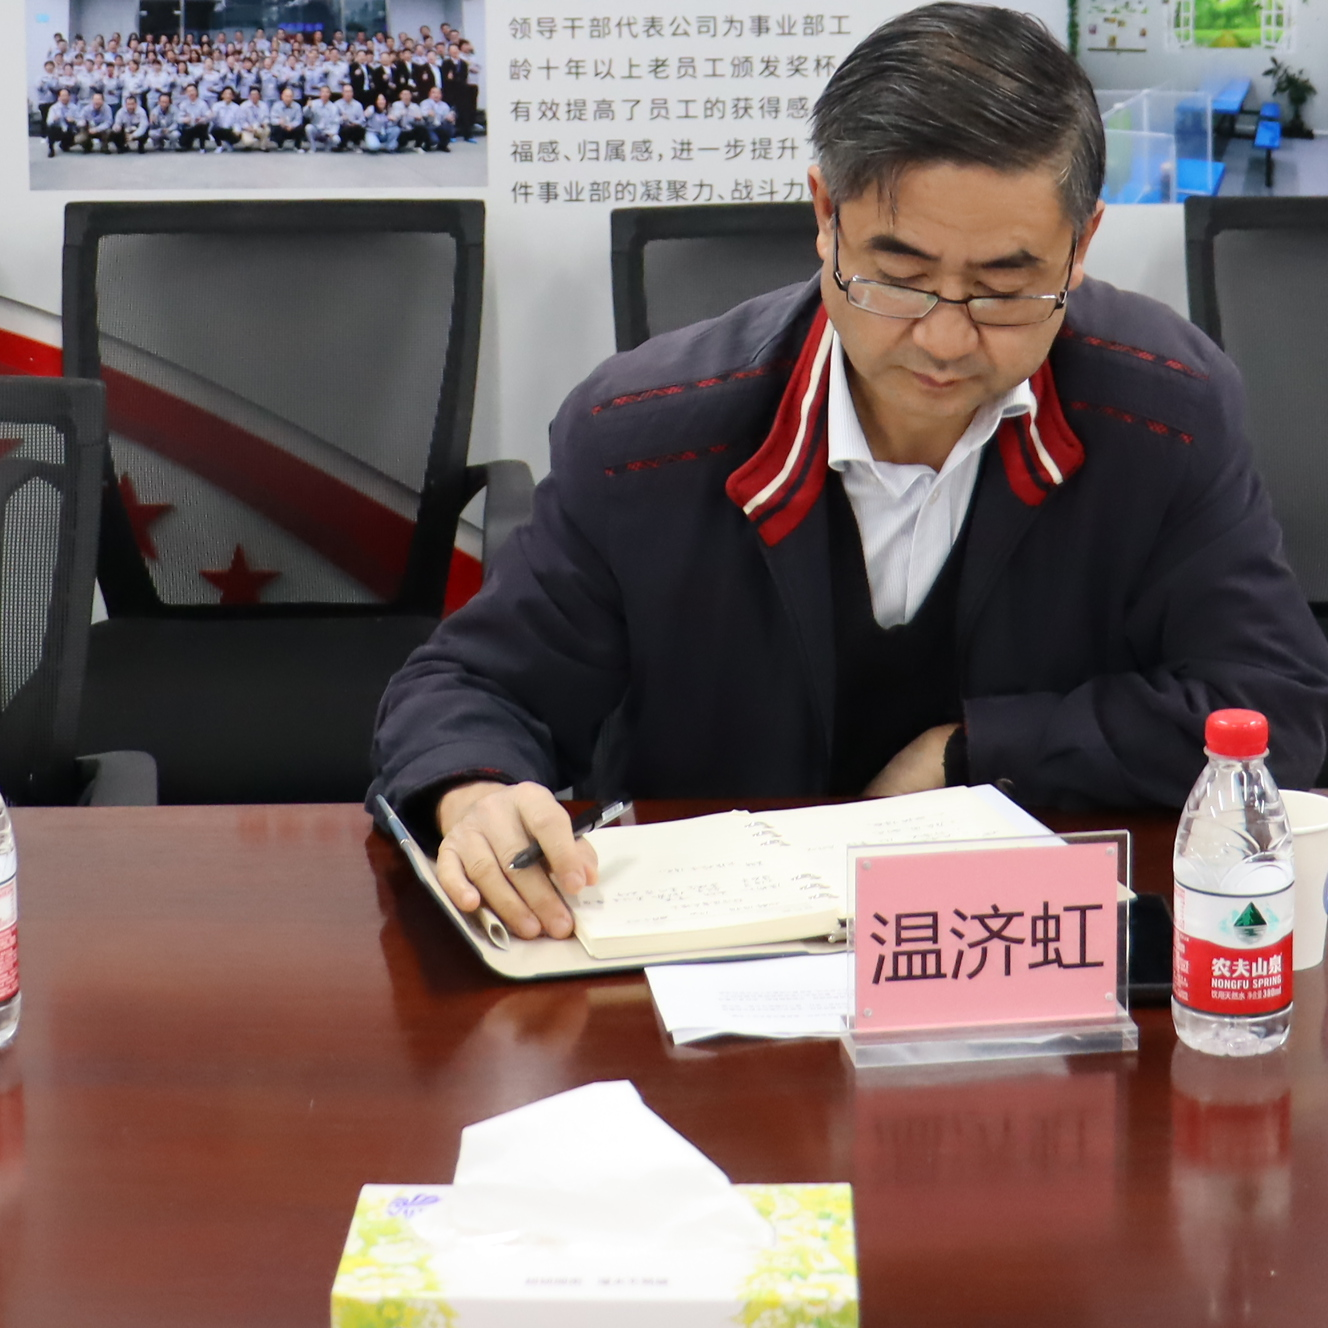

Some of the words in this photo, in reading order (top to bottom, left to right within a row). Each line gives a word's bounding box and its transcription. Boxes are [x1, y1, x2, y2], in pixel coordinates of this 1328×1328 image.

[509, 14, 851, 40] 领导干部代表公司为事业部工
[871, 901, 1105, 985] 温济虹
[1211, 954, 1283, 978] 农夫山泉
[1211, 977, 1249, 990] NONGFU
[1252, 974, 1282, 988] SPRING
